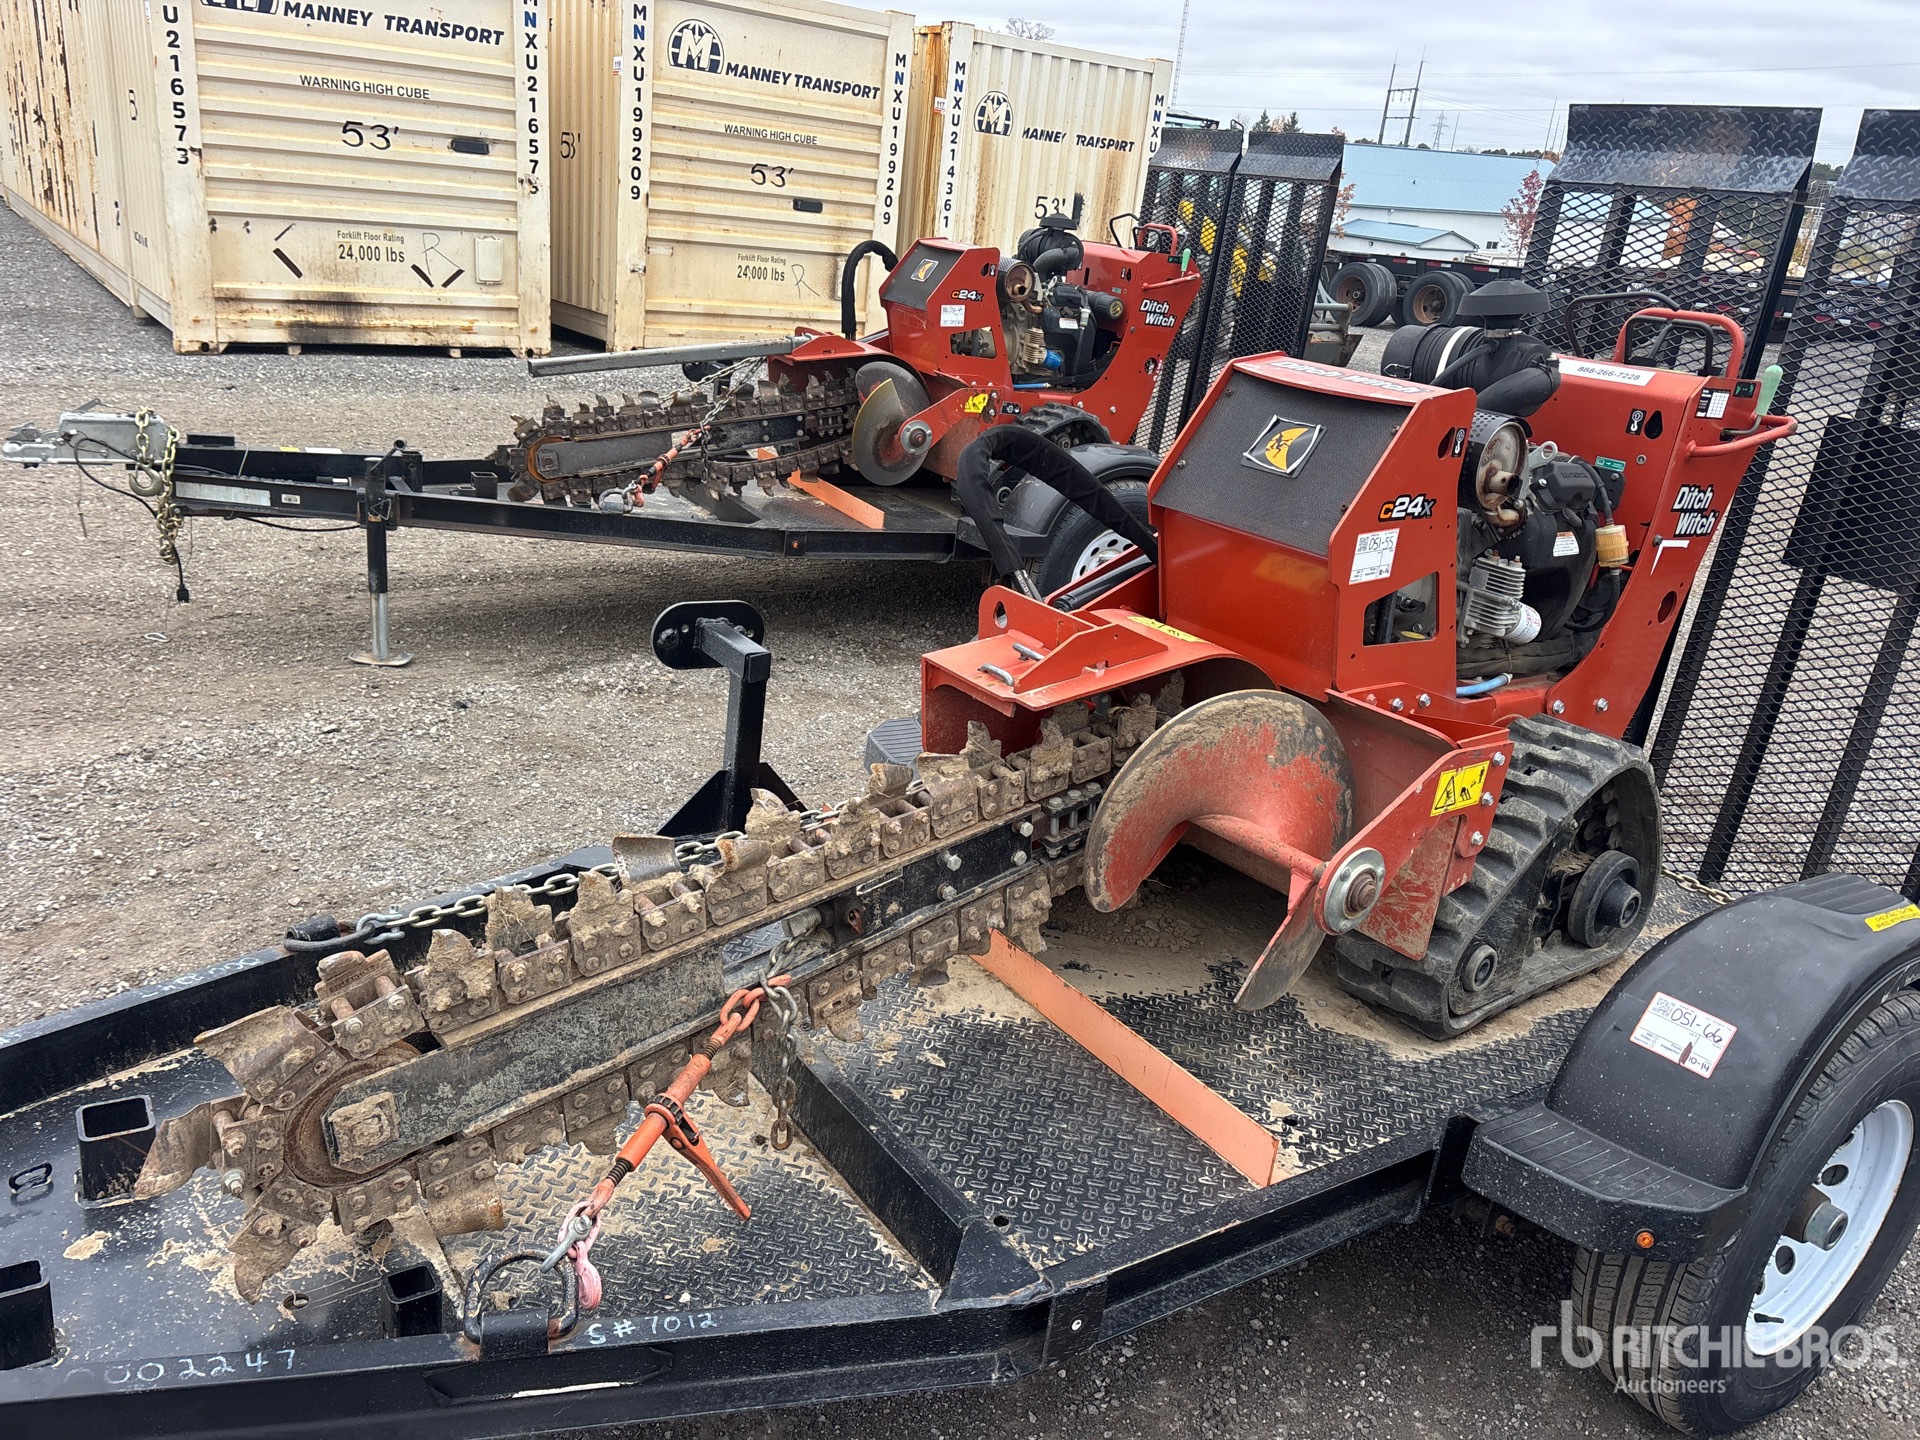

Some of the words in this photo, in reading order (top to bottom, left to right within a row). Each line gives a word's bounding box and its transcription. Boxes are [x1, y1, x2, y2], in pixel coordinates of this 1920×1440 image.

[283, 1, 373, 27] MANNEY
[384, 15, 505, 46] TRANSPORT
[300, 75, 361, 92] WARNING
[364, 81, 394, 96] HIGH
[397, 86, 430, 100] CUBE
[725, 62, 791, 86] MANNEY
[794, 74, 880, 100] TRANSPORT
[342, 120, 399, 150] 53'
[724, 124, 768, 139] WARNING
[770, 131, 791, 142] HIGH
[794, 134, 818, 145] CUBE
[1022, 127, 1067, 144] MANNEY
[1076, 134, 1135, 153] TRANSPORT
[751, 163, 794, 187] 53'
[337, 230, 362, 241] Forklift
[364, 232, 381, 241] Floor
[383, 233, 405, 244] Rating
[338, 244, 381, 263] 24,000
[386, 247, 405, 262] lbs
[738, 253, 756, 262] Forklift
[757, 255, 770, 263] Floor
[771, 256, 787, 265] Rating
[737, 265, 768, 282] 24,000
[771, 268, 785, 281] lbs
[1140, 300, 1169, 314] Ditch
[1145, 312, 1177, 327] Witch
[1270, 361, 1341, 378] Ditch
[1341, 374, 1421, 394] Witch
[1577, 366, 1641, 381] 888-266-7228
[1672, 485, 1714, 509] Ditch
[1675, 512, 1718, 536] Witch
[645, 1312, 717, 1334] 7012
